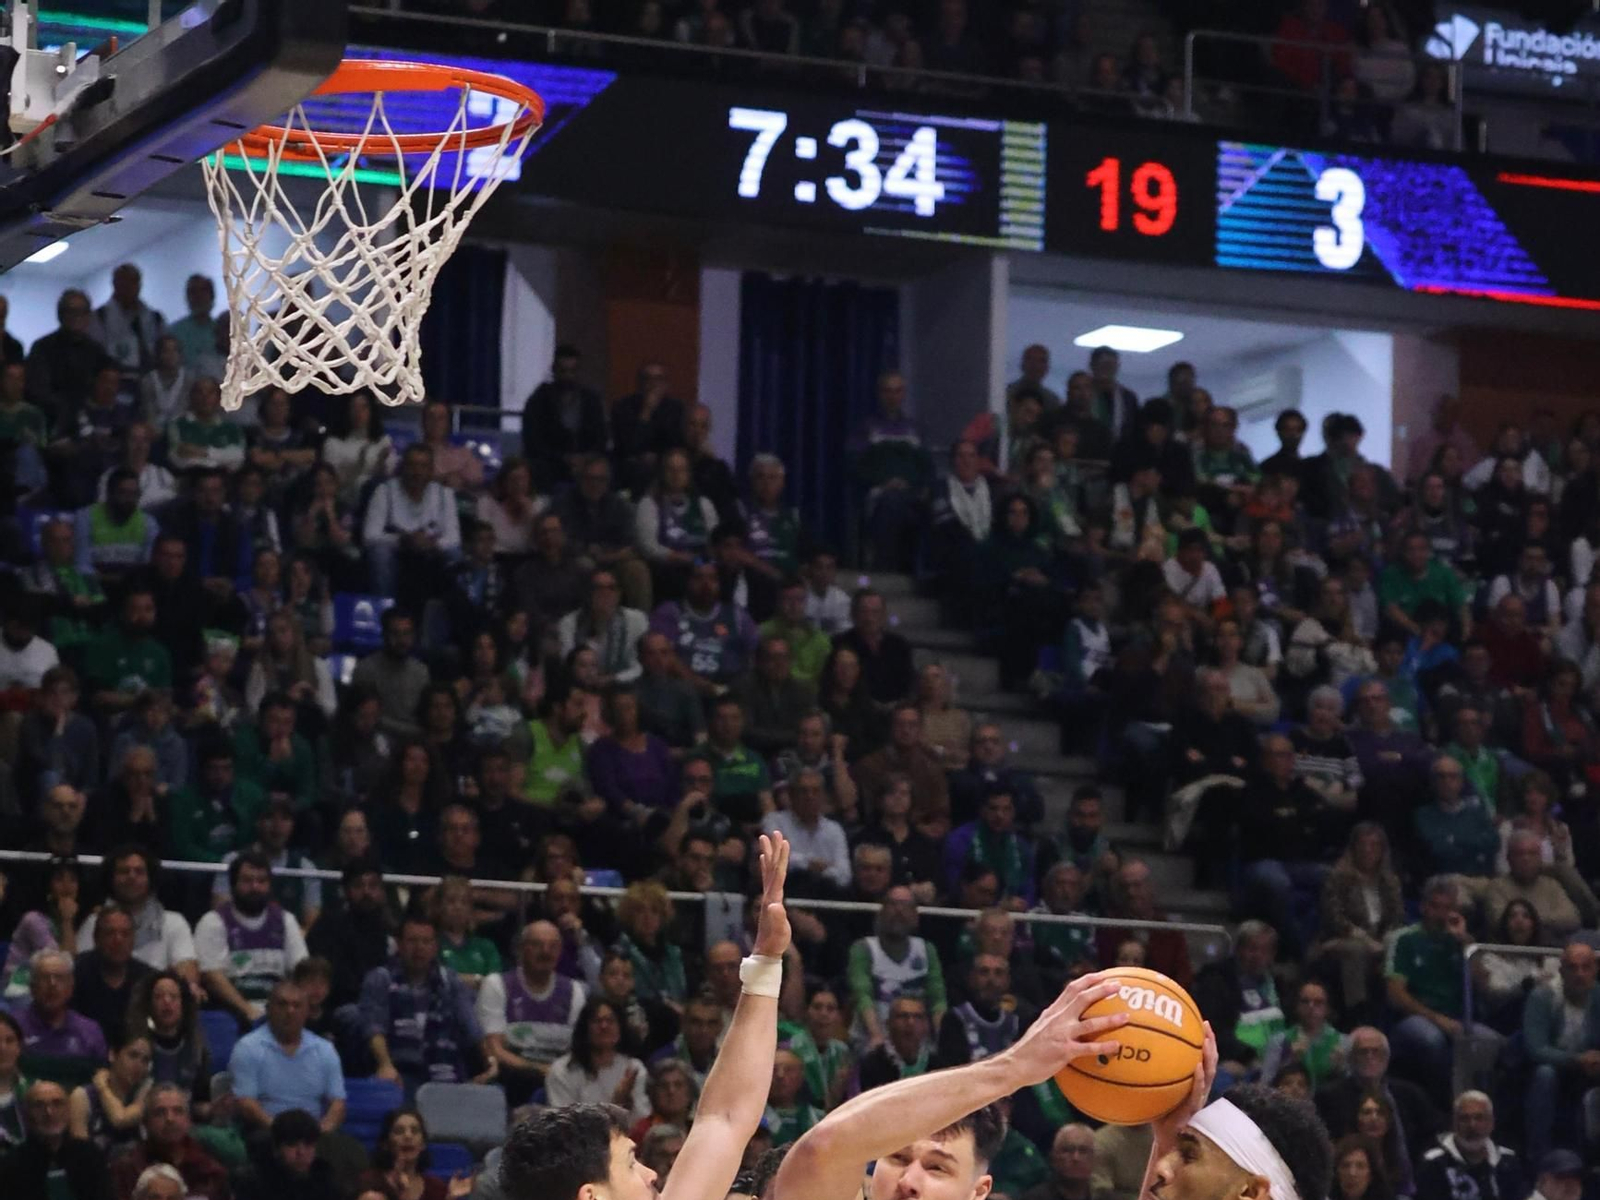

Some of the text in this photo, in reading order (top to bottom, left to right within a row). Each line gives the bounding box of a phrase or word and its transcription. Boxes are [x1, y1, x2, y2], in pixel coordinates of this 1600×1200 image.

[729, 107, 944, 217] 7:34
[1086, 156, 1177, 236] 19
[1313, 167, 1365, 270] 3
[1117, 985, 1183, 1027] Wils
